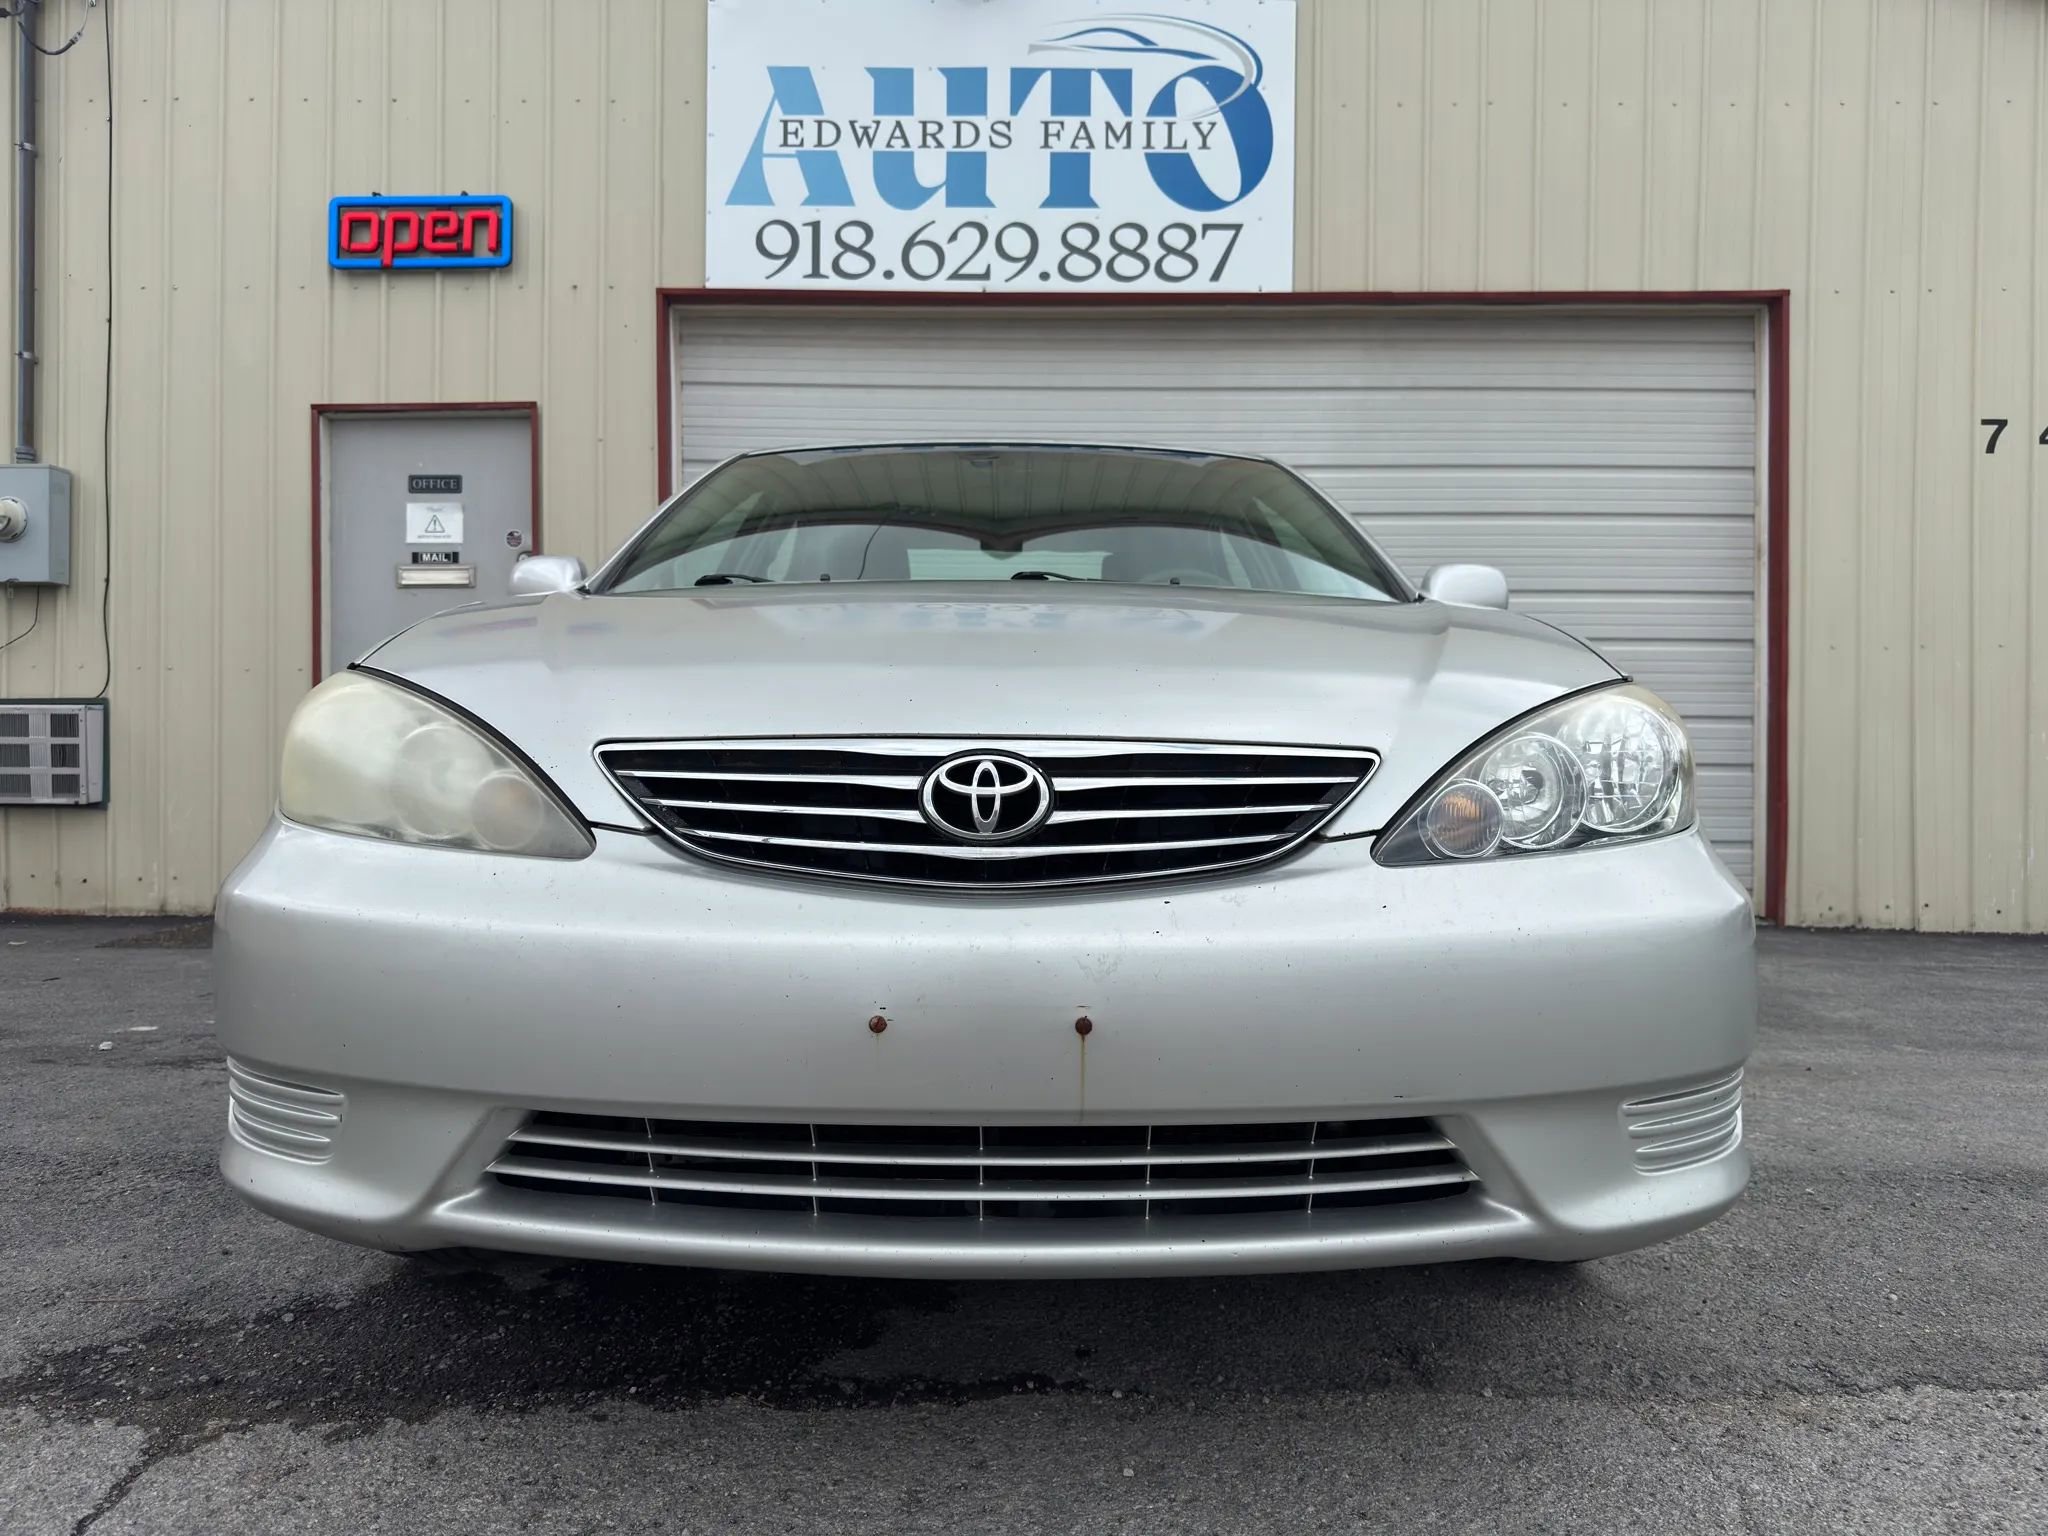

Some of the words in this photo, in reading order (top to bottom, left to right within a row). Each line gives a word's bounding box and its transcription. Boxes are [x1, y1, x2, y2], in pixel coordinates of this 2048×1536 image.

[724, 65, 1274, 212] AUTO
[778, 119, 1013, 149] EDWARDS
[1039, 120, 1218, 150] FAMILY
[340, 210, 499, 269] open
[755, 219, 1244, 283] 918.629.8887
[412, 479, 458, 489] OFFICE
[422, 553, 448, 562] MAIL
